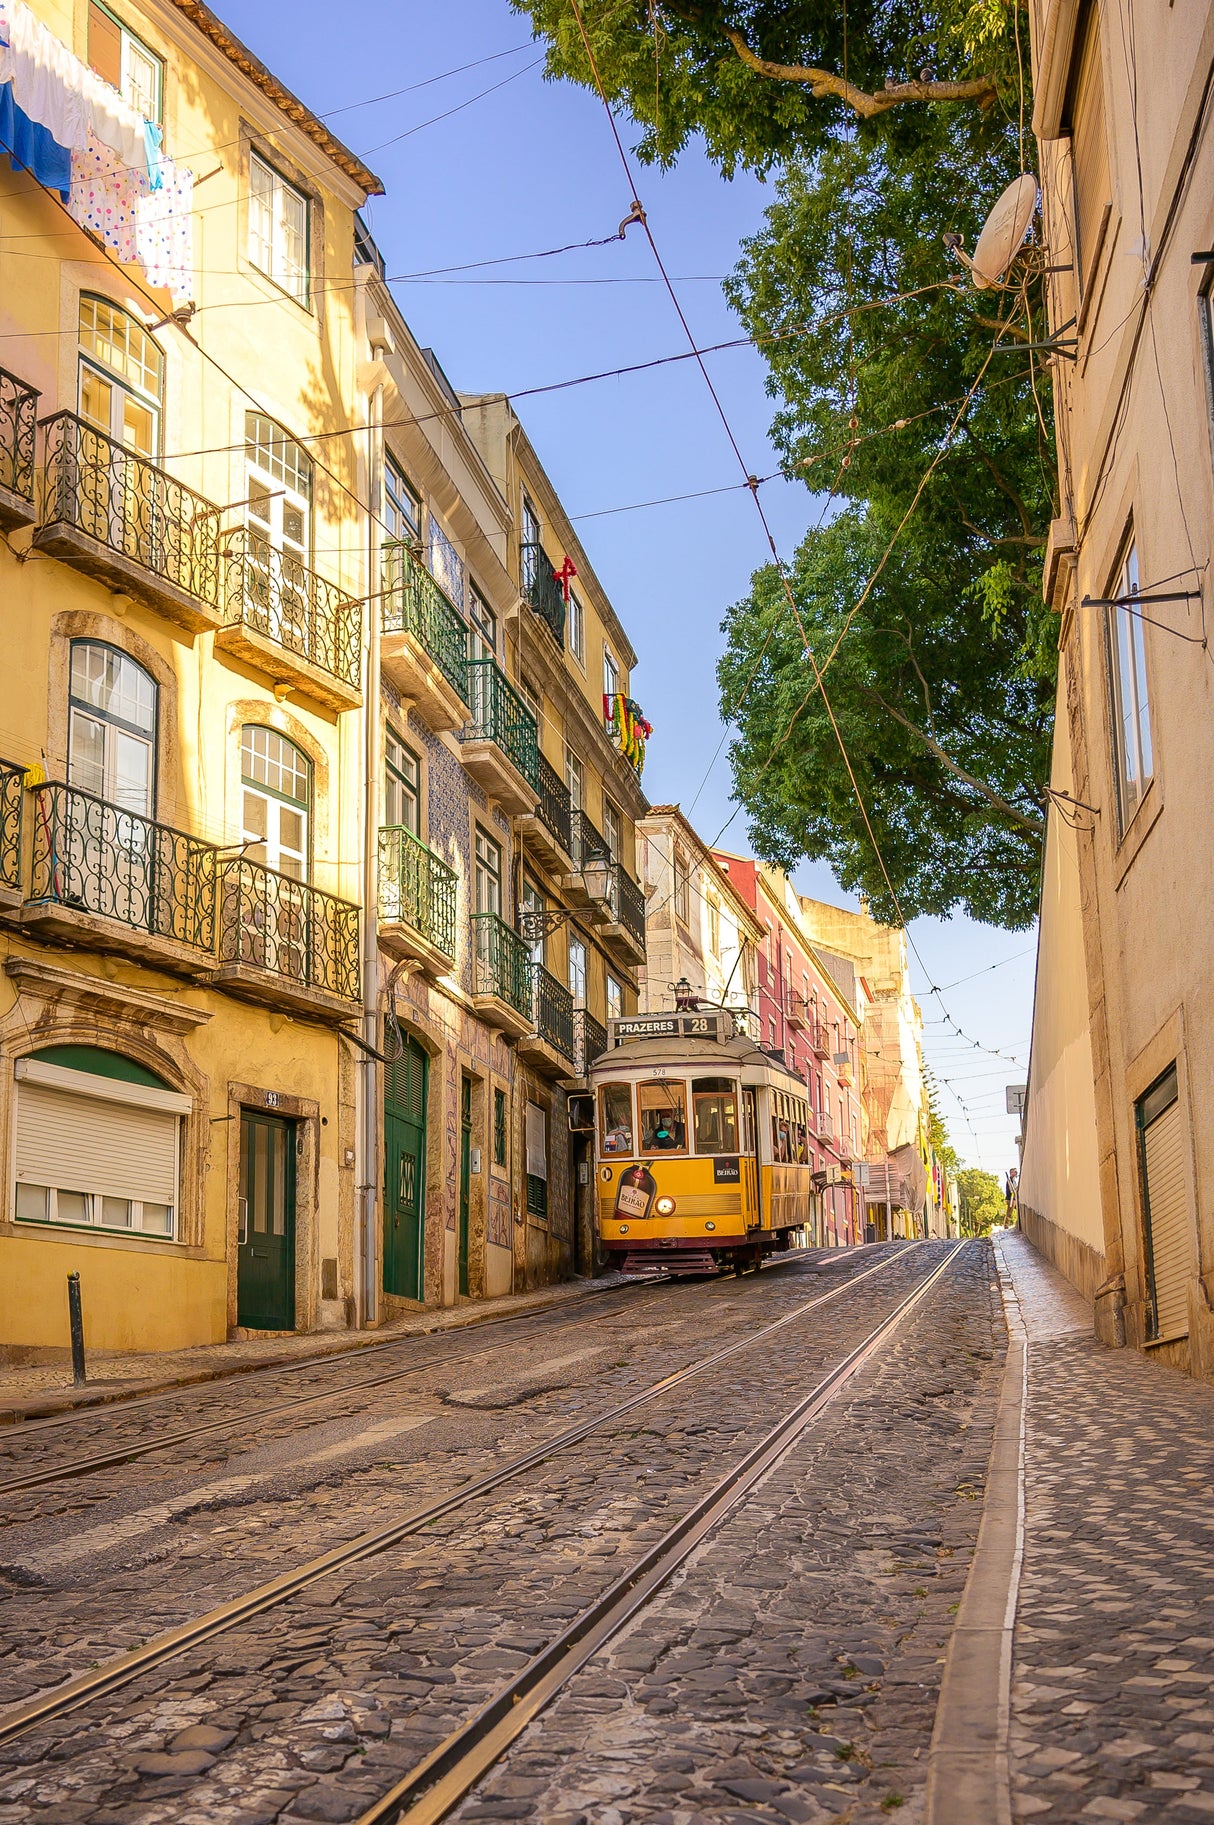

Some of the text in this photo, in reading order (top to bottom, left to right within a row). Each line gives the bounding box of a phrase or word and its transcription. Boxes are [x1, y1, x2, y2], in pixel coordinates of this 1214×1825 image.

[619, 1018, 708, 1033] PRAZERES 28
[652, 1068, 666, 1076] 578
[268, 1092, 277, 1107] 93
